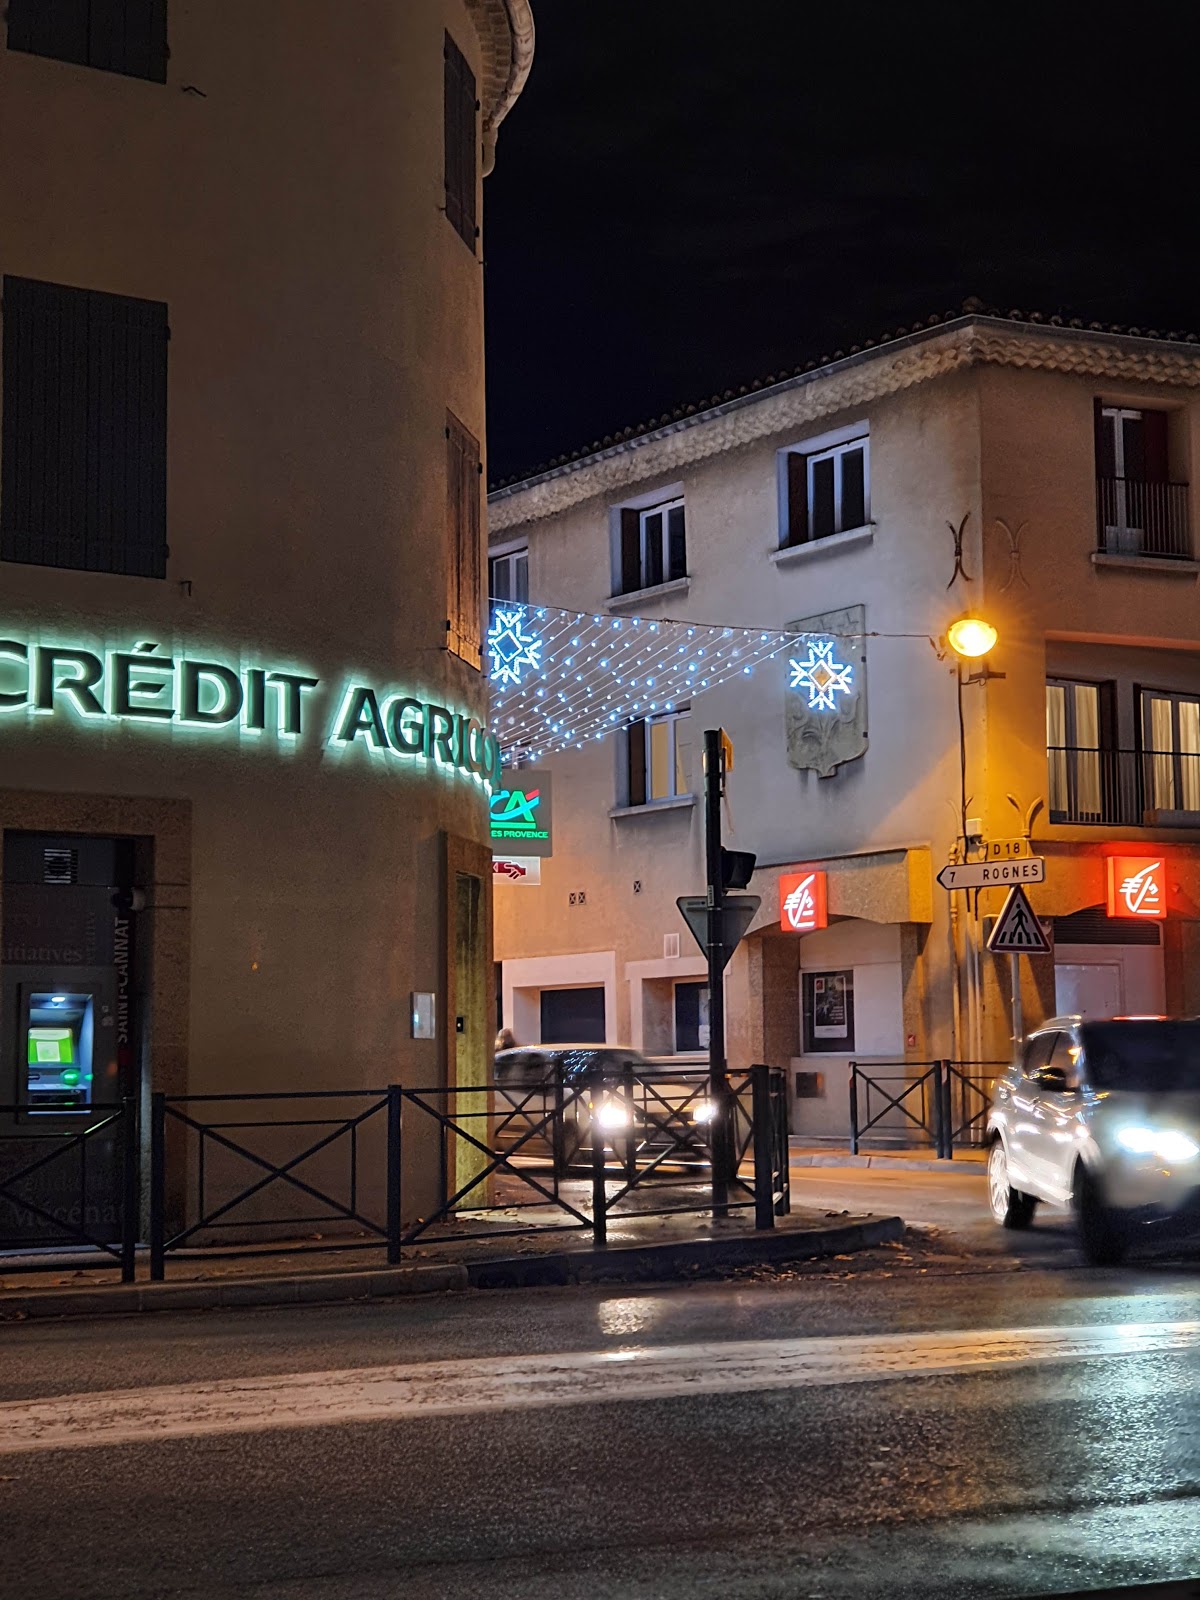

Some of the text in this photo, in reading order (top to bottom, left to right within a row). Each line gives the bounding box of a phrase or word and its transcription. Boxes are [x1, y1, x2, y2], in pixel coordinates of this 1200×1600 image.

[336, 686, 502, 788] AGRICO
[504, 830, 549, 839] PROVENCE
[994, 842, 1020, 855] D 18
[949, 864, 1039, 883] 7 ROGNES
